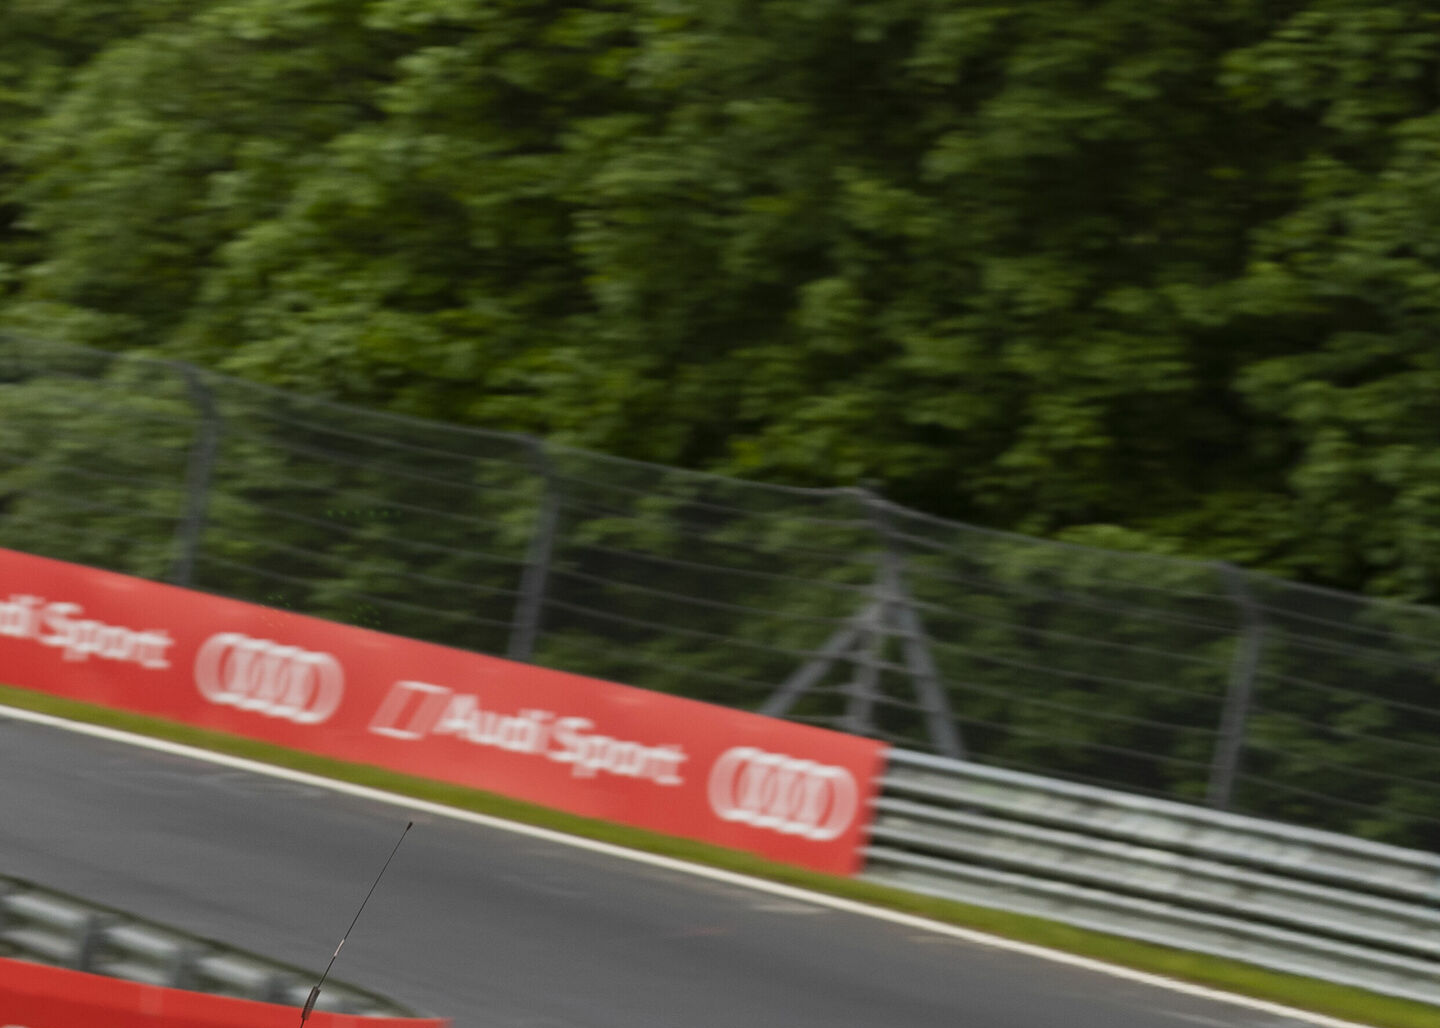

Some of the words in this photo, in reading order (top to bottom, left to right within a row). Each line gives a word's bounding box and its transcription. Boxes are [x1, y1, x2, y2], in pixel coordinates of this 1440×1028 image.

[38, 601, 173, 668] Sport
[436, 694, 552, 754] Audi
[542, 717, 688, 786] Sport
